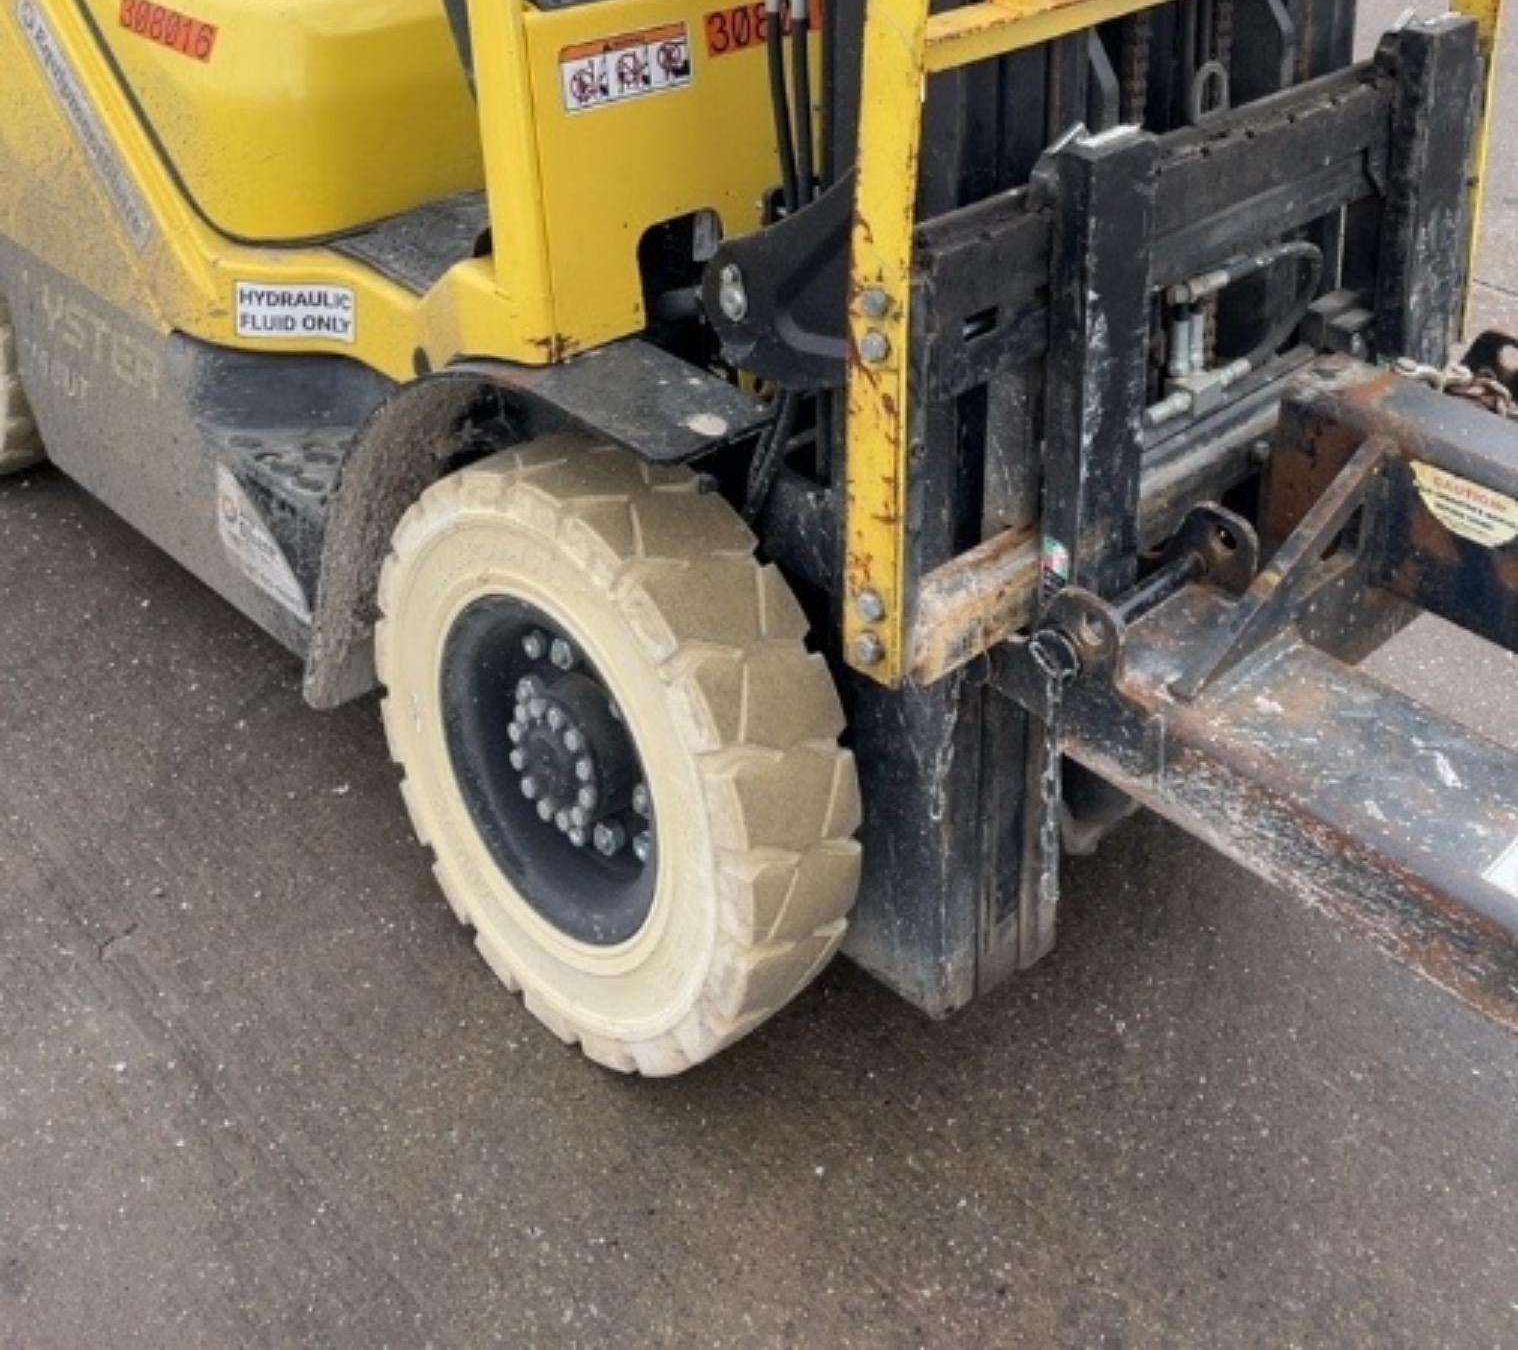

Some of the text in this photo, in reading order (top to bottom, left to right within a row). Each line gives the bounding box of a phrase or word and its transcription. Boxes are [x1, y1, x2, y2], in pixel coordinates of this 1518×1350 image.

[239, 288, 352, 309] HYDRAULIC
[239, 312, 351, 334] FLUID ONLY
